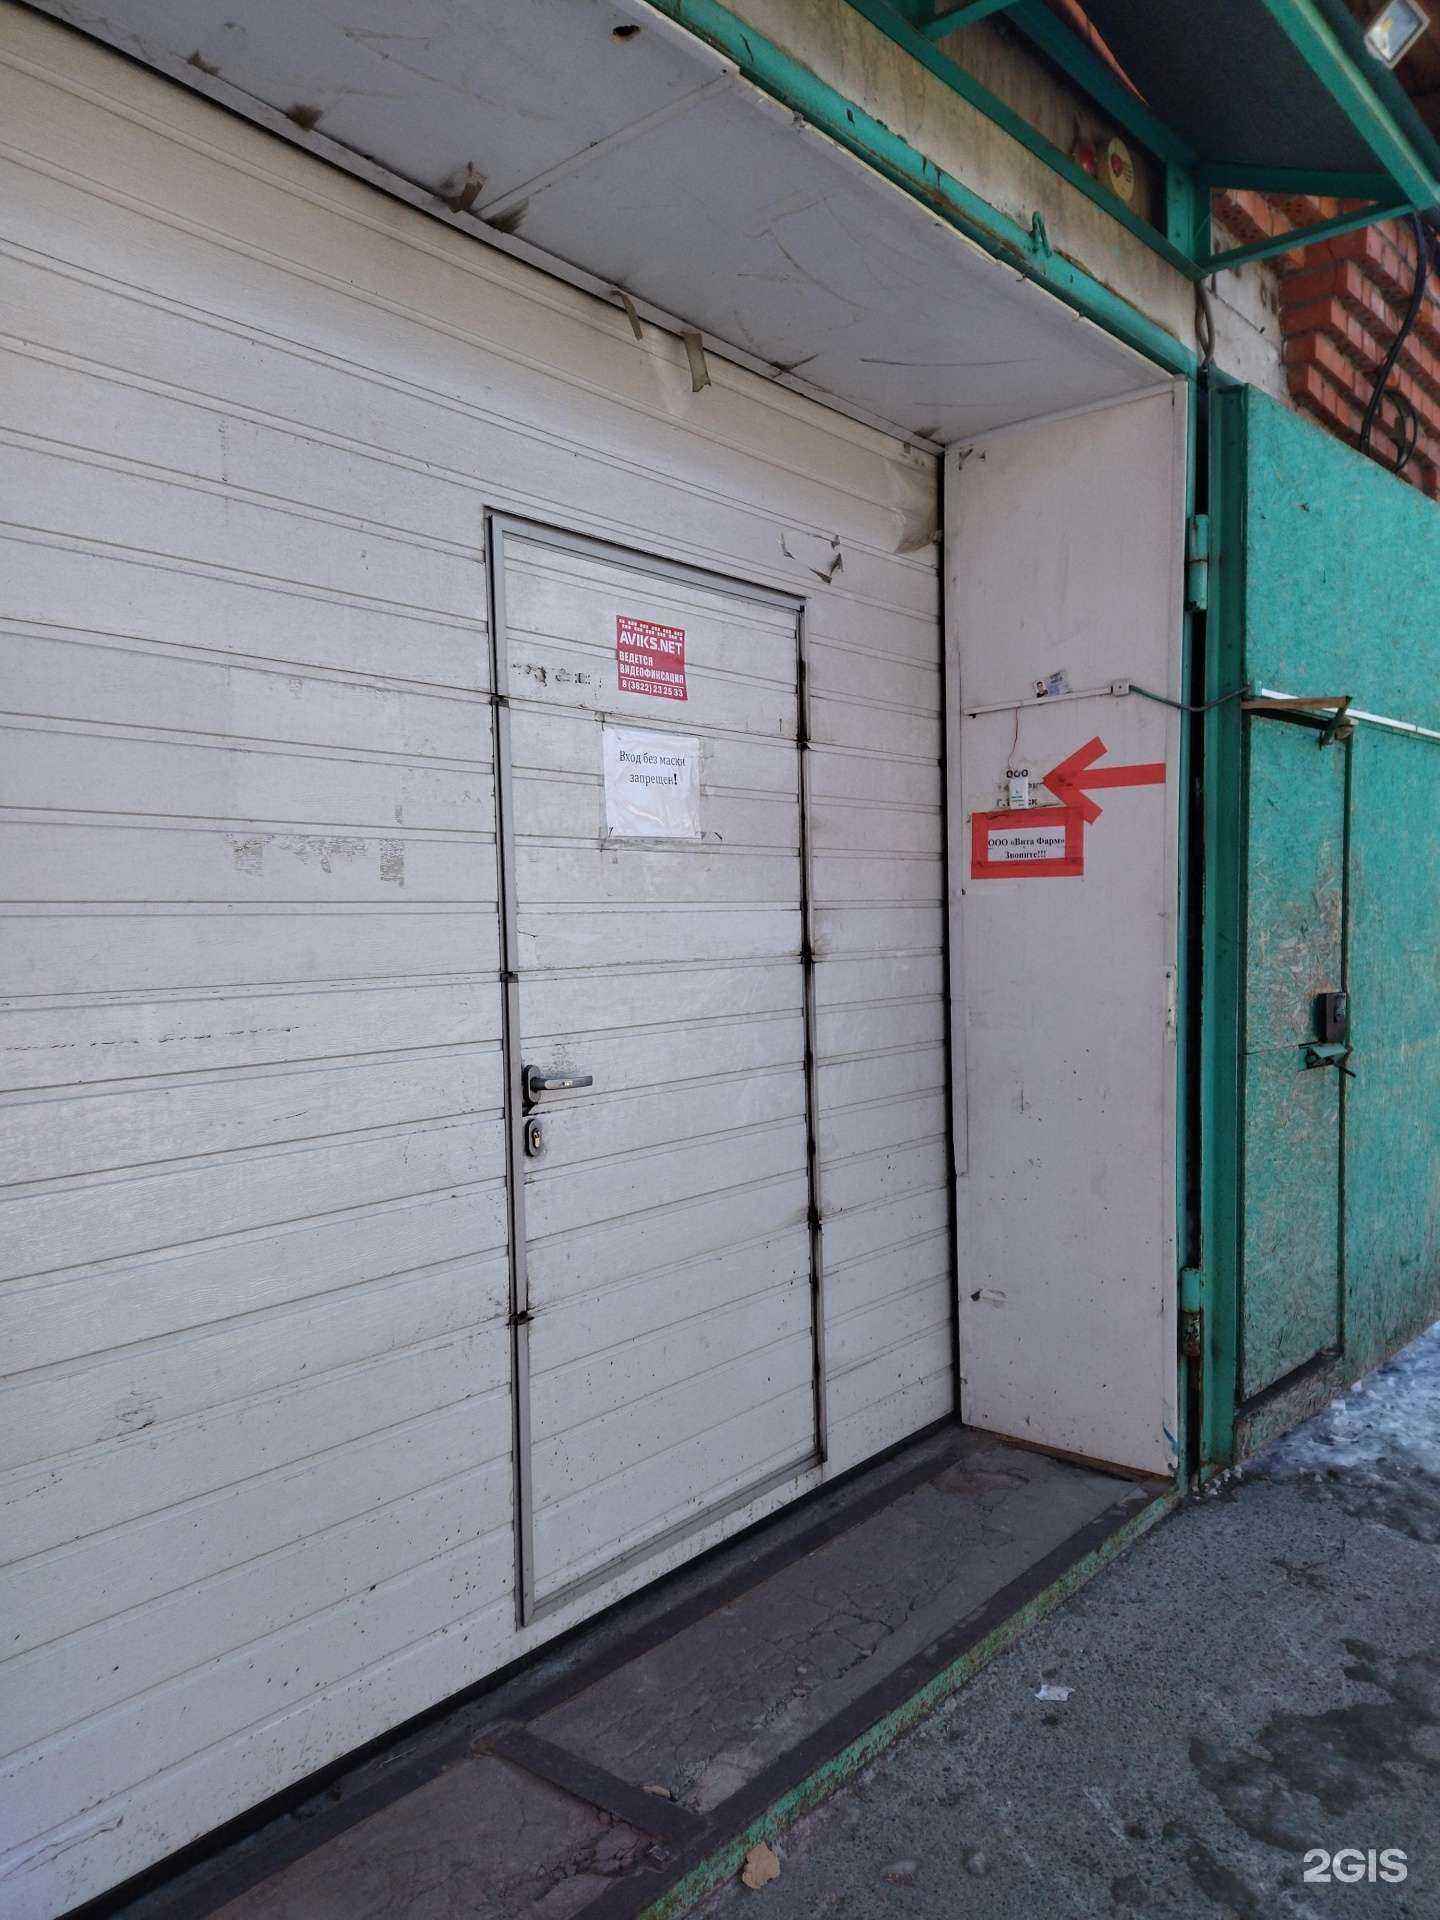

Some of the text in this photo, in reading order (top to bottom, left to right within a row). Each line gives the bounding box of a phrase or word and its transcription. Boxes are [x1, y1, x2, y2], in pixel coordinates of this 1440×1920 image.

[620, 630, 682, 655] AVIKS.NET
[619, 651, 653, 666] ВЕДЕТСЯ
[620, 663, 684, 684] ВИДЕОФИКСАЦИЯ
[622, 680, 627, 688] 8
[628, 680, 652, 694] (3822)
[653, 685, 662, 694] 23
[663, 686, 672, 695] 25
[619, 750, 686, 767] Вход без маски
[630, 773, 678, 787] запрещен!
[988, 838, 1008, 847] ООО
[1005, 850, 1046, 860] Звоните!!!
